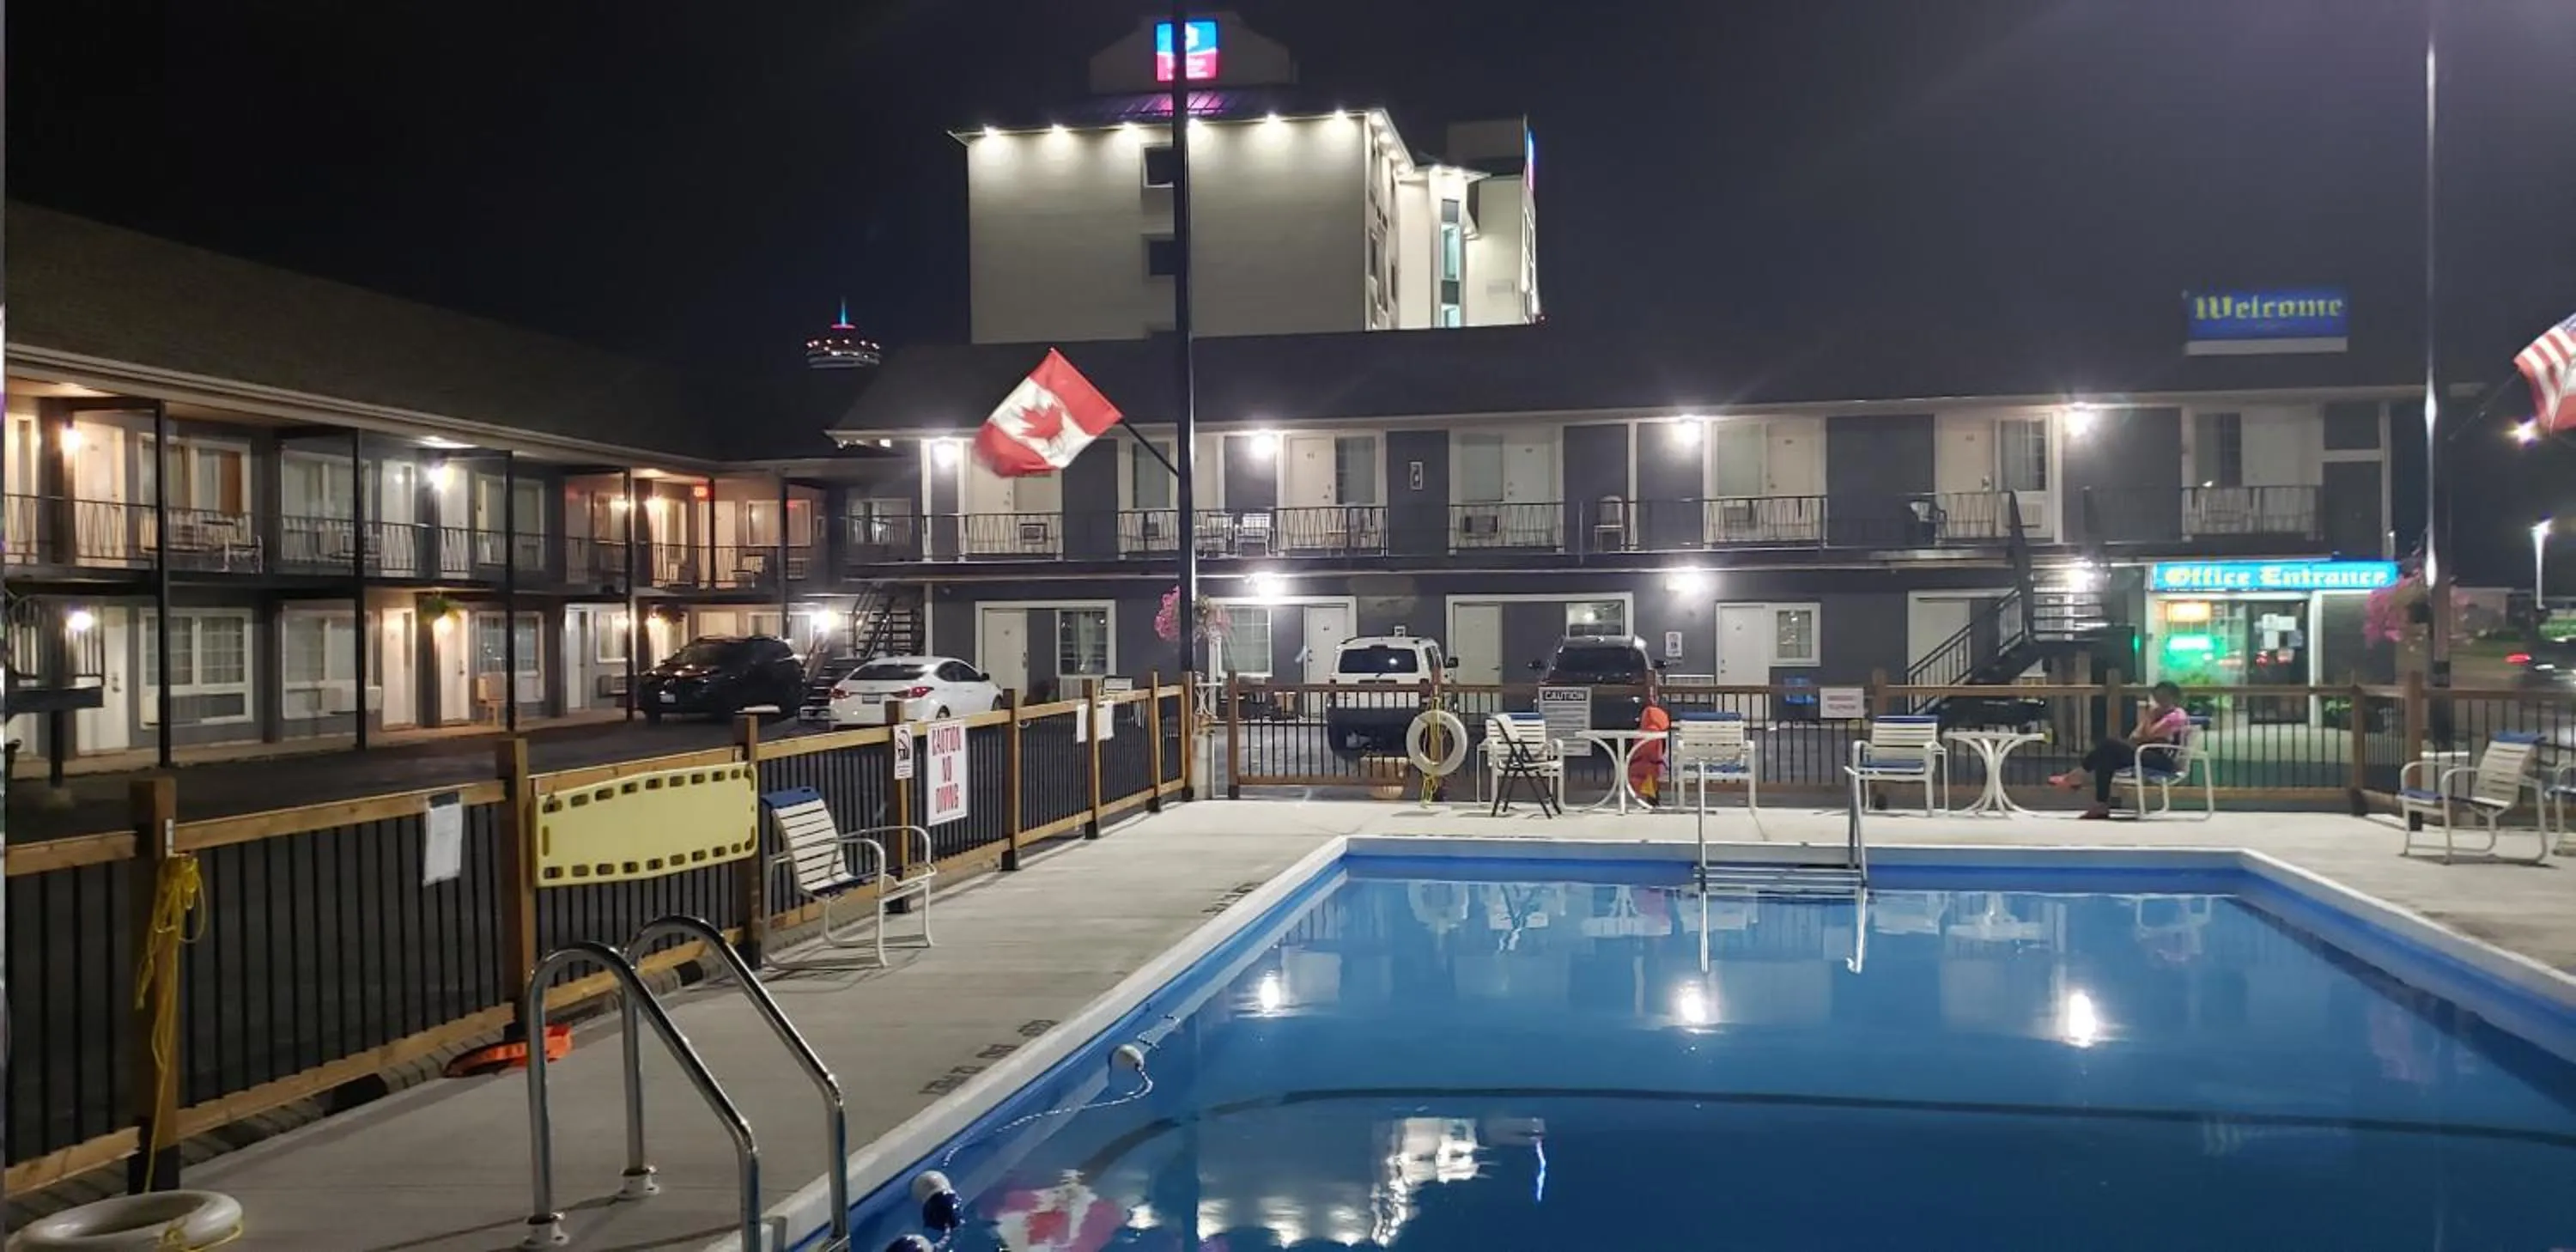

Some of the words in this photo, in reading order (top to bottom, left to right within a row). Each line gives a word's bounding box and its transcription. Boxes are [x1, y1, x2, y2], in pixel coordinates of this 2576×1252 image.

[2196, 295, 2343, 319] Welcome
[2164, 567, 2251, 586] Office
[2260, 565, 2388, 586] Entrance
[1545, 690, 1586, 701] CAUTION
[932, 726, 962, 756] CAUTION
[942, 755, 952, 783] NO
[936, 782, 959, 814] DIVING
